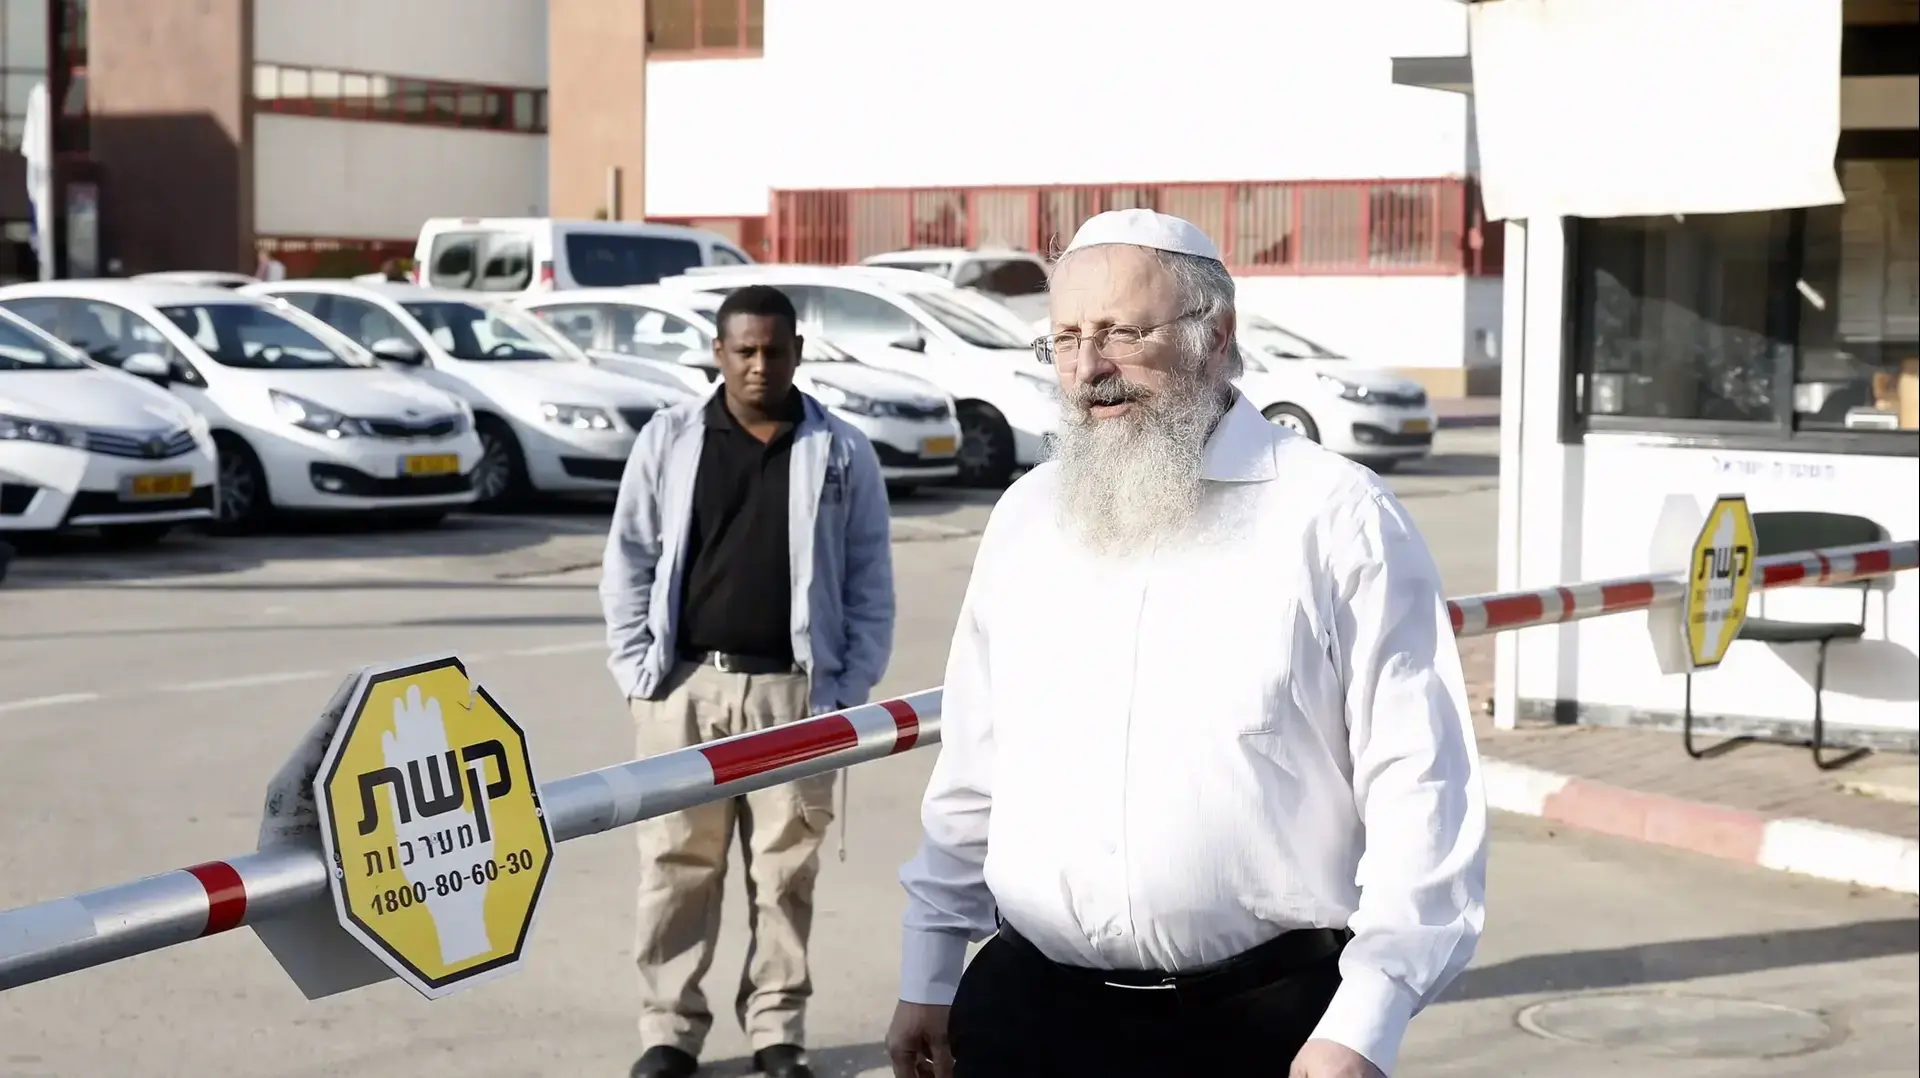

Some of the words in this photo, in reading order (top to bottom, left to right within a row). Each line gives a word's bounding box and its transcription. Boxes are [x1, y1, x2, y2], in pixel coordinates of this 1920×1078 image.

[1698, 546, 1749, 599] קשת
[357, 739, 512, 843] קשת
[363, 823, 474, 877] מערכות
[371, 849, 533, 915] 1800-80-60-30
